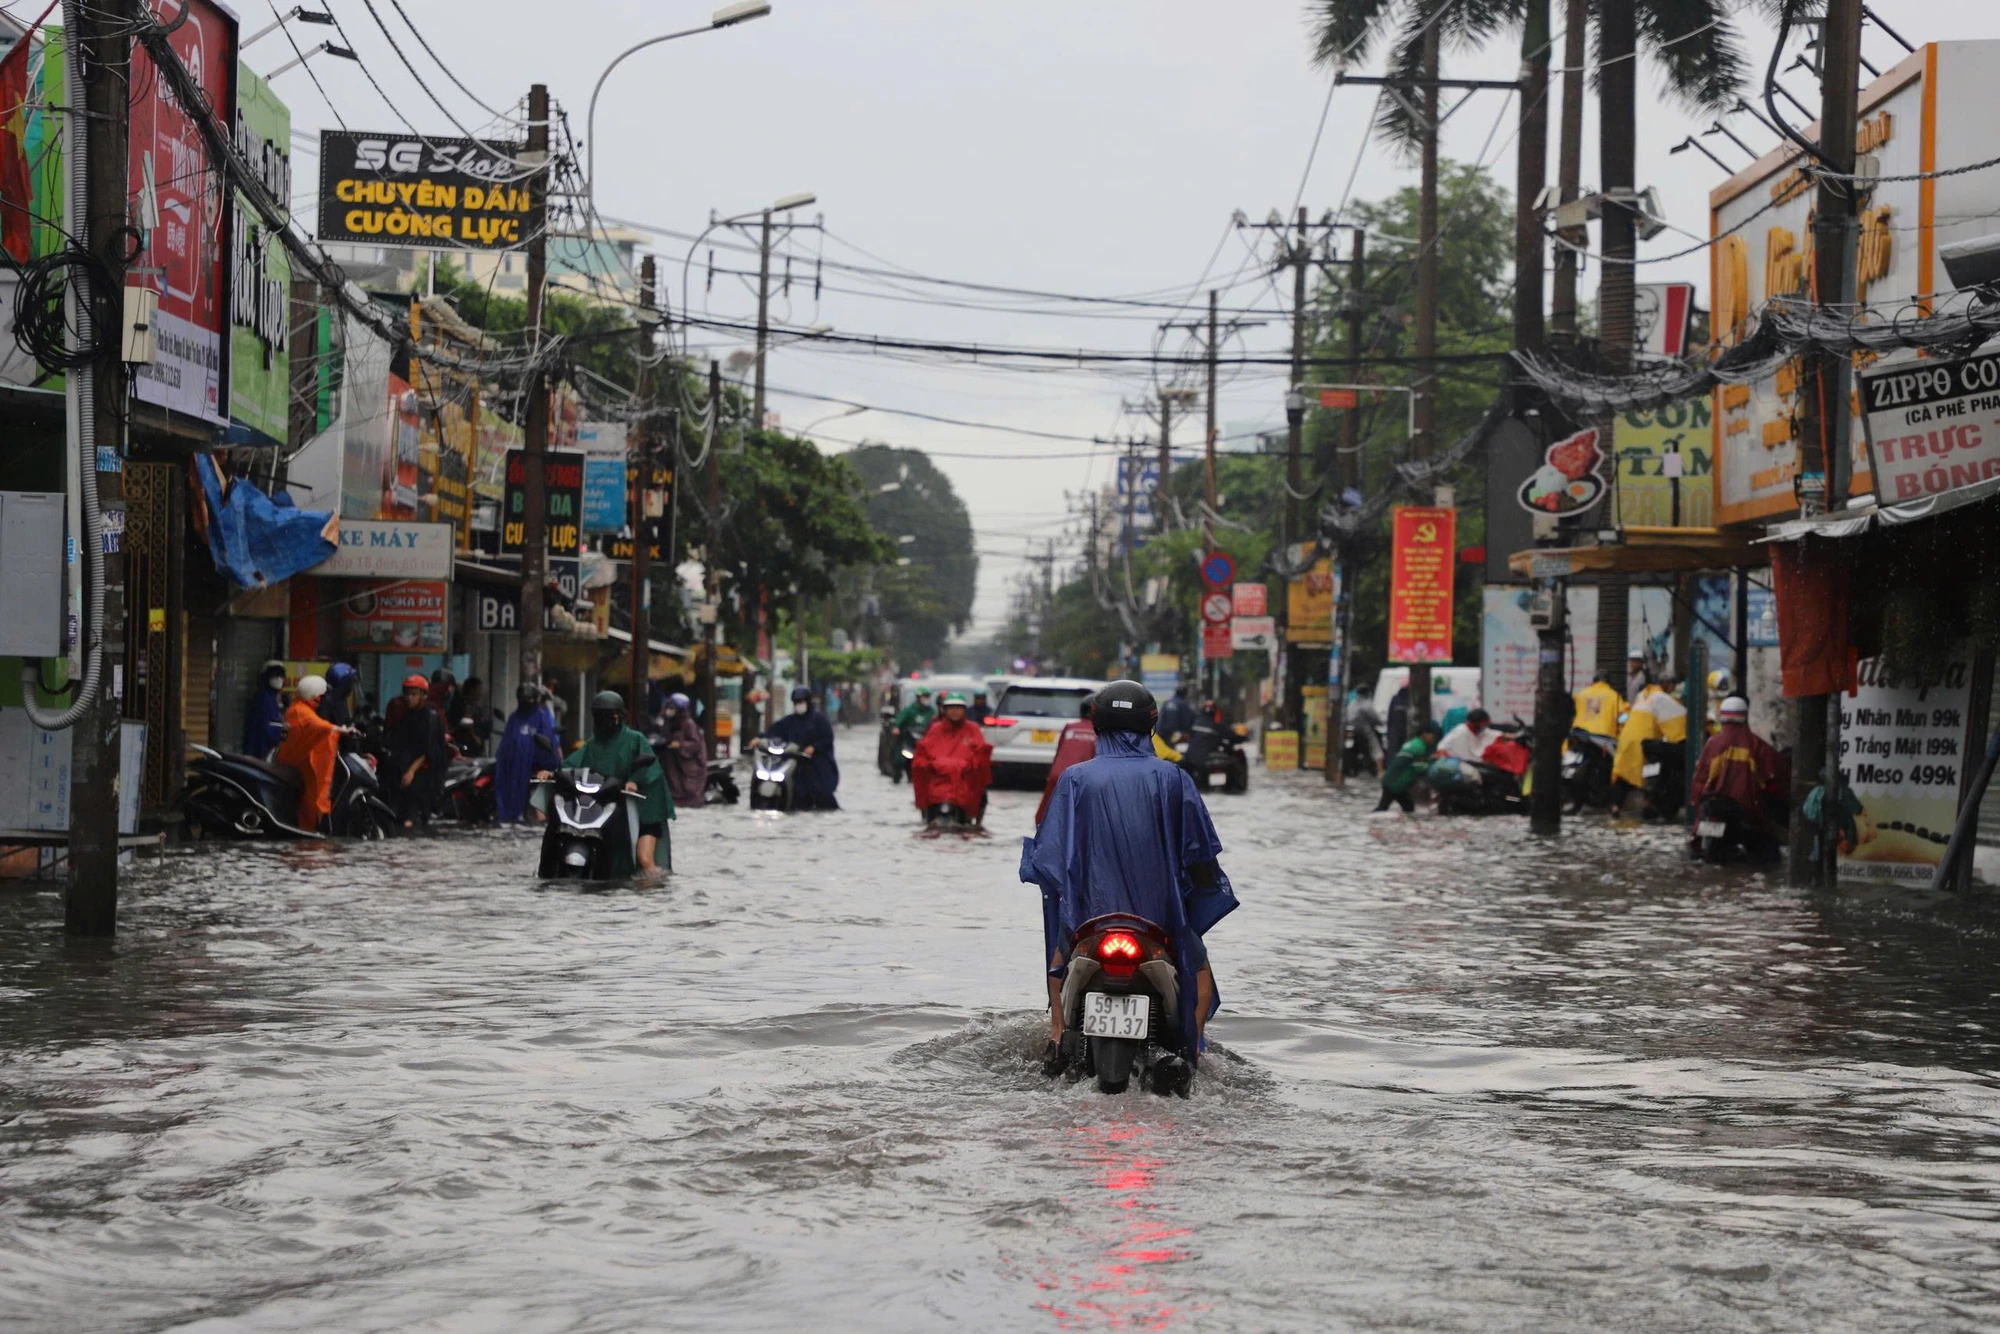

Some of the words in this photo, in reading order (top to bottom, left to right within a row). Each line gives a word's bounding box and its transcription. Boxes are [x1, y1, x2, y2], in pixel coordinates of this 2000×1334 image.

[354, 139, 423, 174] SG
[428, 145, 516, 179] Shop
[335, 178, 457, 210] CHUYÊN
[463, 184, 532, 213] DÁN
[344, 209, 453, 239] CƯỜNG
[461, 215, 519, 245] LỰC
[1871, 368, 1952, 407] ZIPPO
[1961, 358, 2000, 391] CO
[1936, 397, 1967, 420] PHÊ
[1876, 424, 1983, 464] TRỰC
[370, 527, 421, 548] MÁY
[552, 523, 577, 553] LỰC
[1856, 708, 1891, 727] Nhân
[1895, 708, 1927, 732] Mụn
[1931, 708, 1961, 728] 99k
[1895, 737, 1922, 760] Mặt
[1856, 764, 1904, 784] Meso
[1909, 764, 1957, 786] 499k
[1088, 1015, 1144, 1036] 251.37
